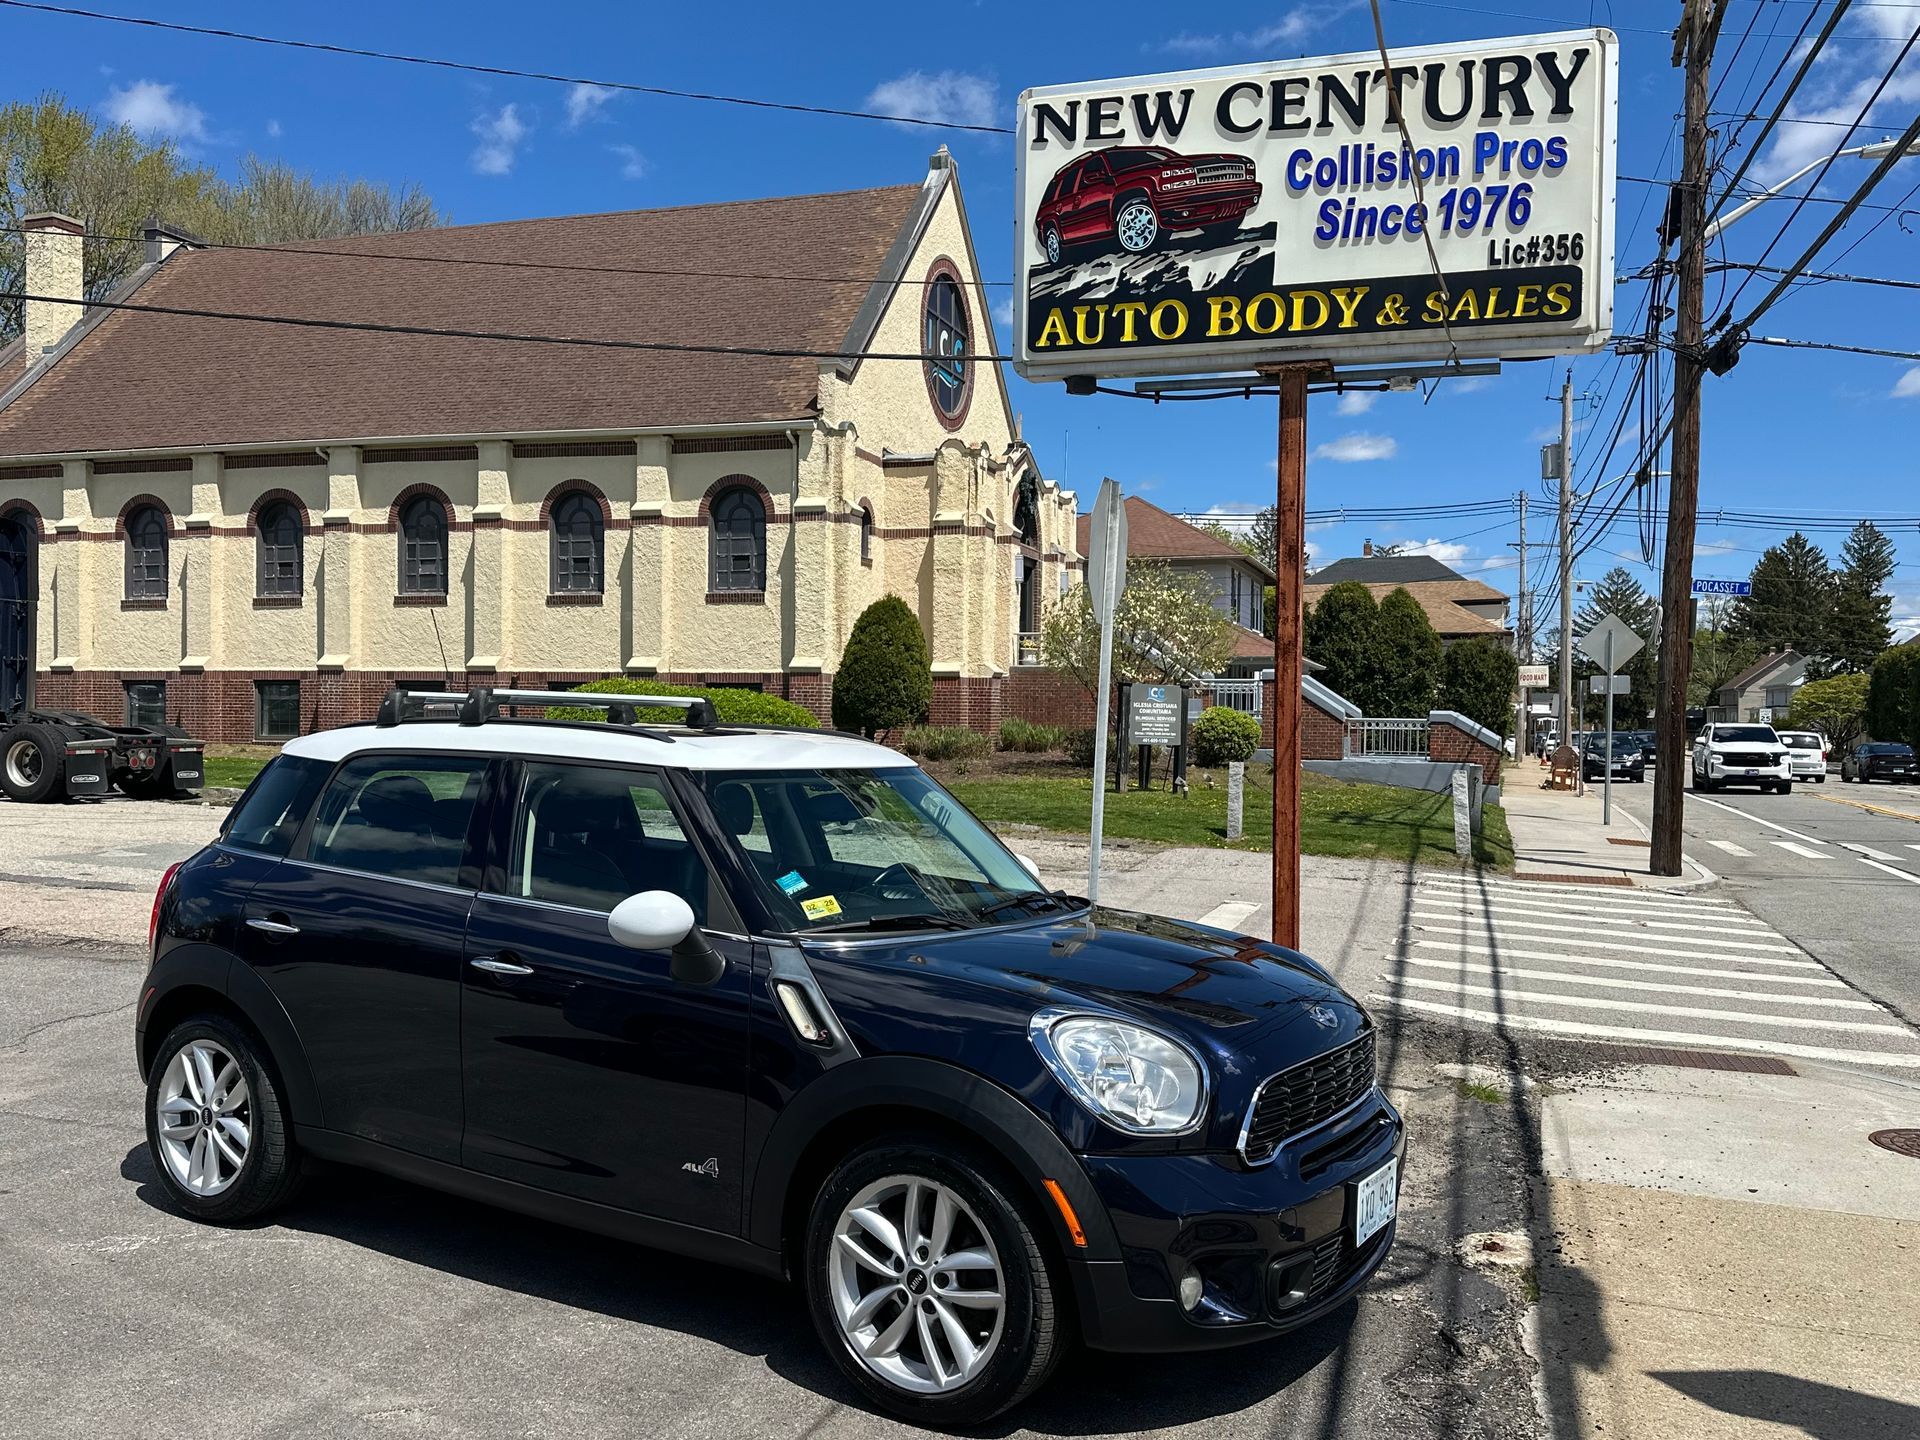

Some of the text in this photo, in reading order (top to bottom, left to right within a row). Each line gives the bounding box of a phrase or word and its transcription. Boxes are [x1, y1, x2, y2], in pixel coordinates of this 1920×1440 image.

[1032, 48, 1590, 143] NEW CENTURY
[1287, 131, 1568, 190] Collision Pros
[1316, 182, 1533, 241] Since 1976
[1490, 233, 1584, 265] Lic#356
[1035, 283, 1573, 347] AUTO BODY & SALES
[1696, 581, 1740, 593] POCASSET
[1380, 1176, 1393, 1211] 962
